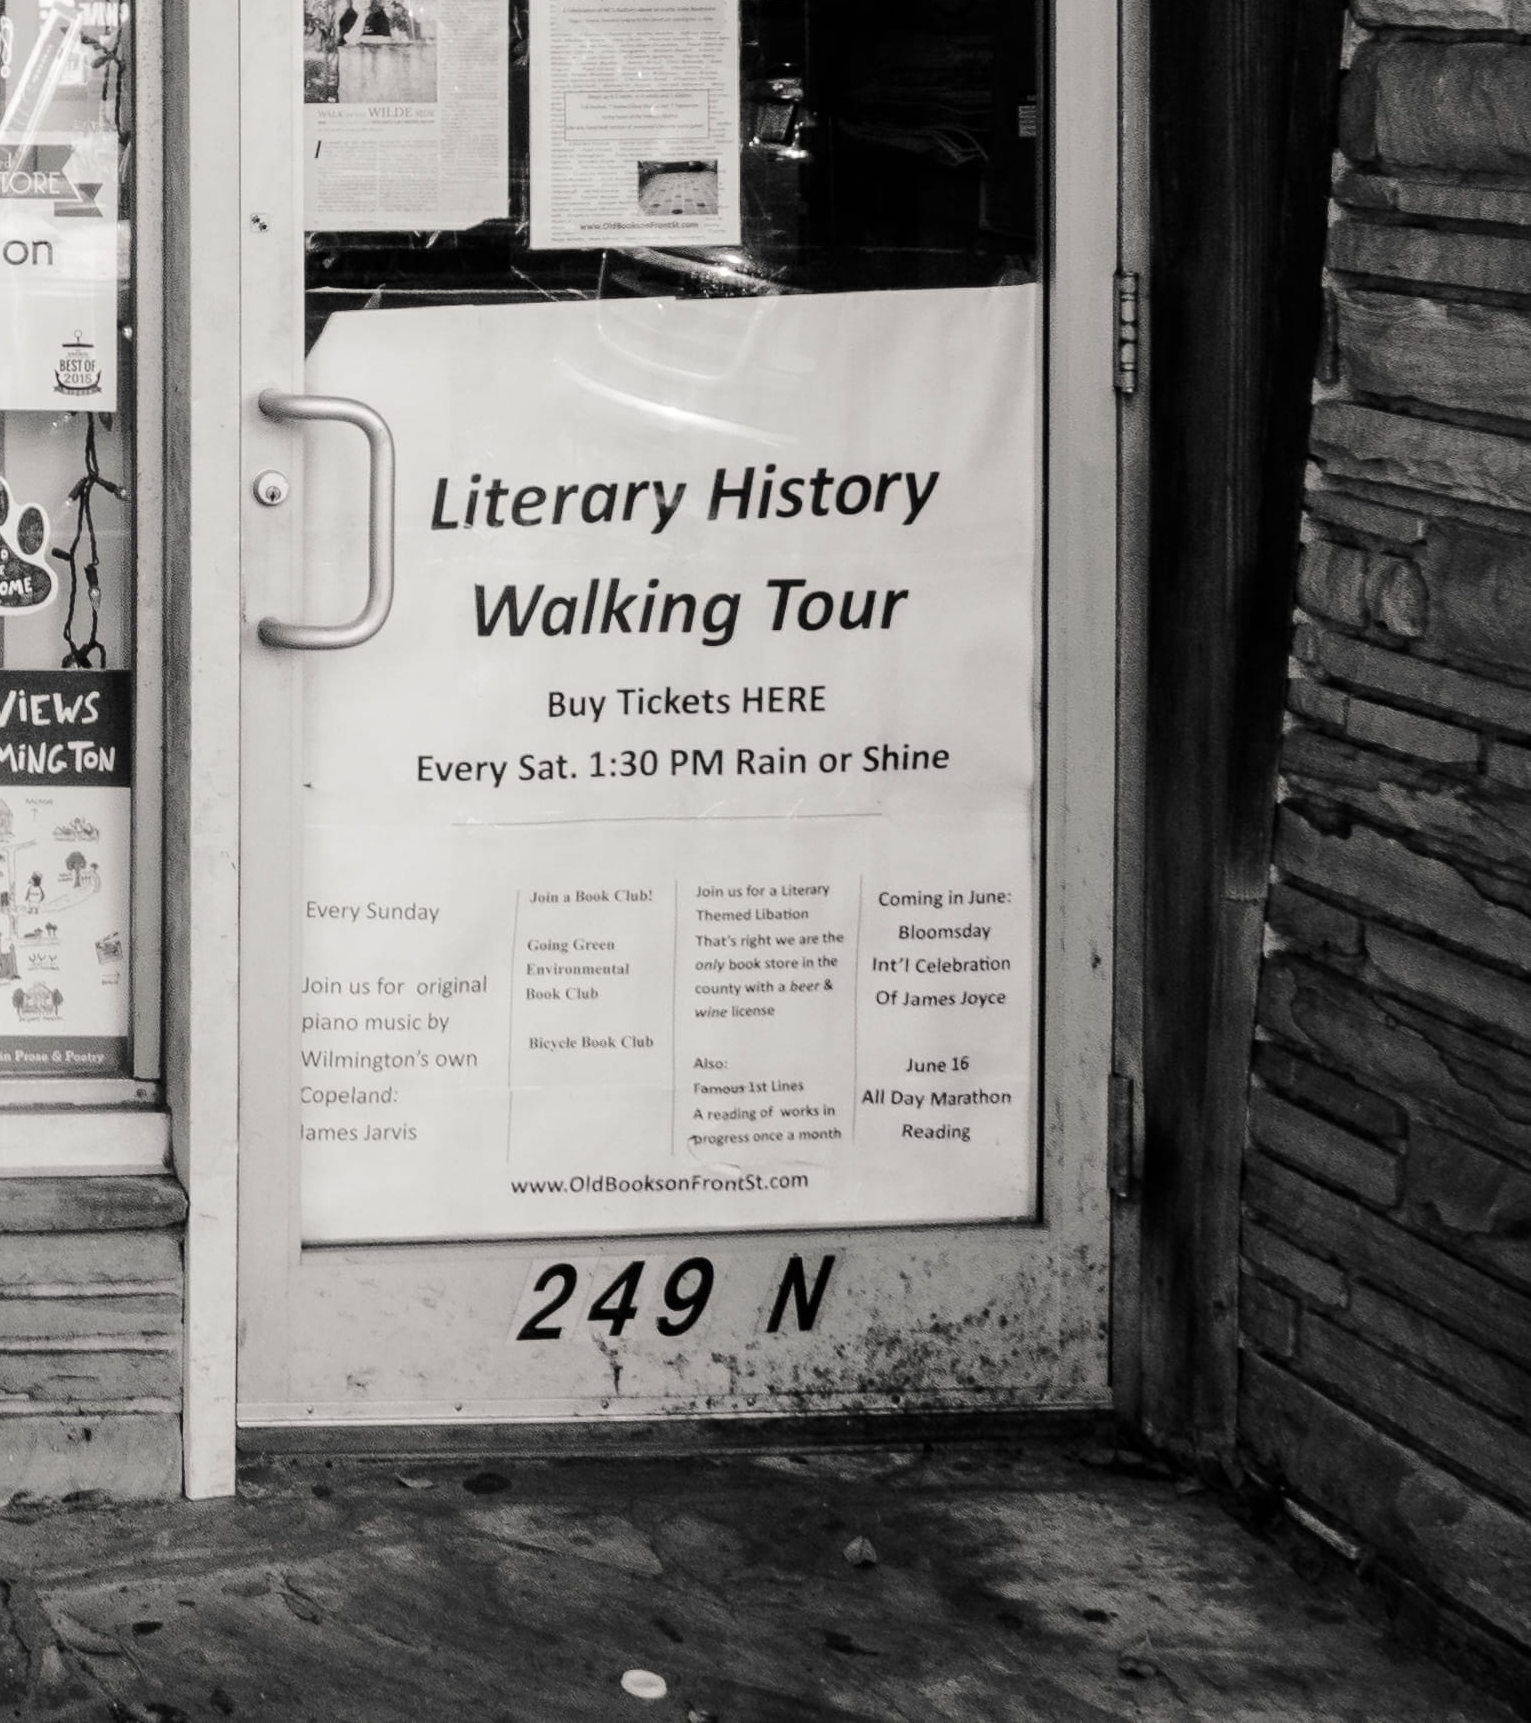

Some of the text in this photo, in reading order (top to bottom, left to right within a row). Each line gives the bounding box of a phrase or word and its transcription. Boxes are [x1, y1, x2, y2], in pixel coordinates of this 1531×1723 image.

[3, 238, 54, 266] on
[59, 358, 96, 372] BEST OF
[63, 373, 93, 385] 2015
[430, 463, 940, 536] Literary History
[471, 577, 910, 646] Walking Tour
[547, 685, 826, 725] Buy Tickets HERE
[417, 744, 951, 788] Every Sat. 1:30 PM Rain or Shine
[529, 889, 654, 904] Join a Book Club!
[878, 889, 1012, 908] Coming in June:
[306, 901, 440, 924] Every Sunday
[898, 924, 991, 941] Bloomsday
[872, 956, 1011, 974] Int'l Celebration
[301, 975, 488, 999] Join us for original
[876, 990, 1007, 1008] Of James Joyce
[301, 1012, 449, 1033] piano music by
[0, 1050, 13, 1062] in
[15, 1051, 48, 1063] Prose
[51, 1051, 62, 1062] &
[65, 1050, 105, 1064] Poetry
[301, 1049, 478, 1072] Wilmington's own
[511, 1172, 808, 1195] www.OldBooksonFrontSt.com
[516, 1254, 836, 1341] 249 N
